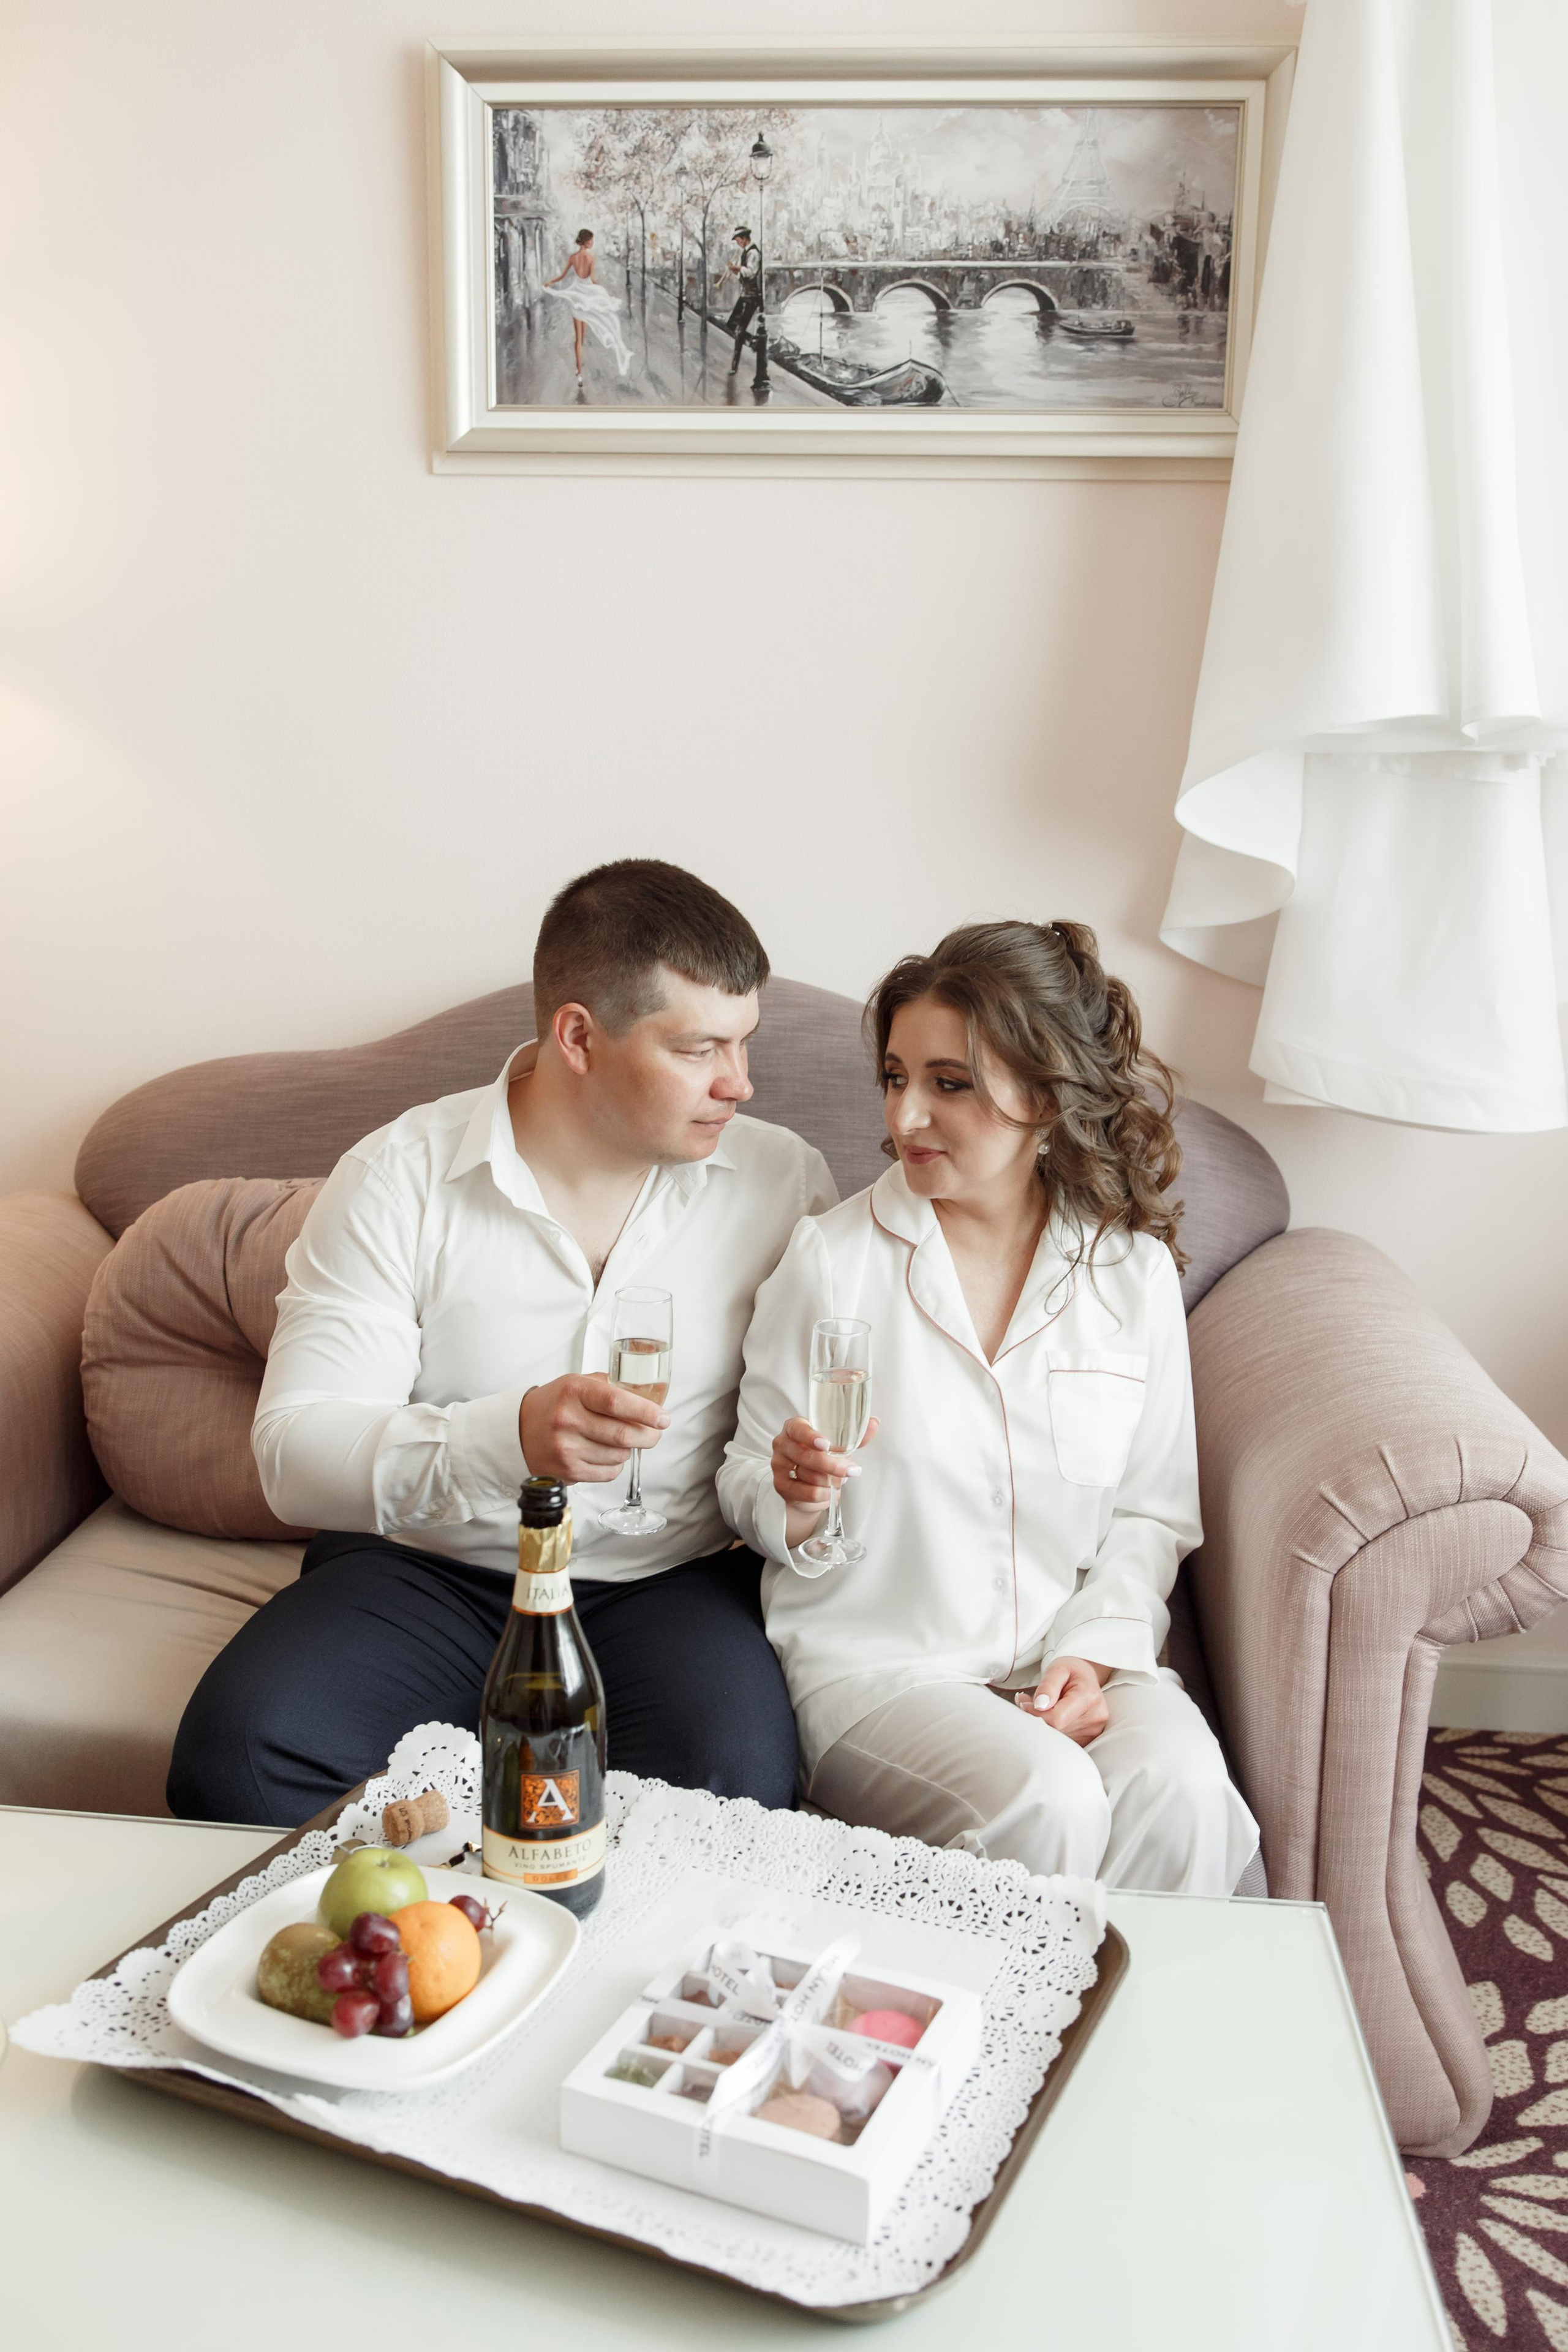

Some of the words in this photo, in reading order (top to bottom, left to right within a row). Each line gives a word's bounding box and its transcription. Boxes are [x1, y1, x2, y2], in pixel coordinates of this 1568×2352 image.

[526, 1778, 574, 1822] A
[508, 1839, 591, 1860] ALFABETO
[540, 1855, 586, 1869] SPUMANTE
[790, 1993, 812, 2022] HOT
